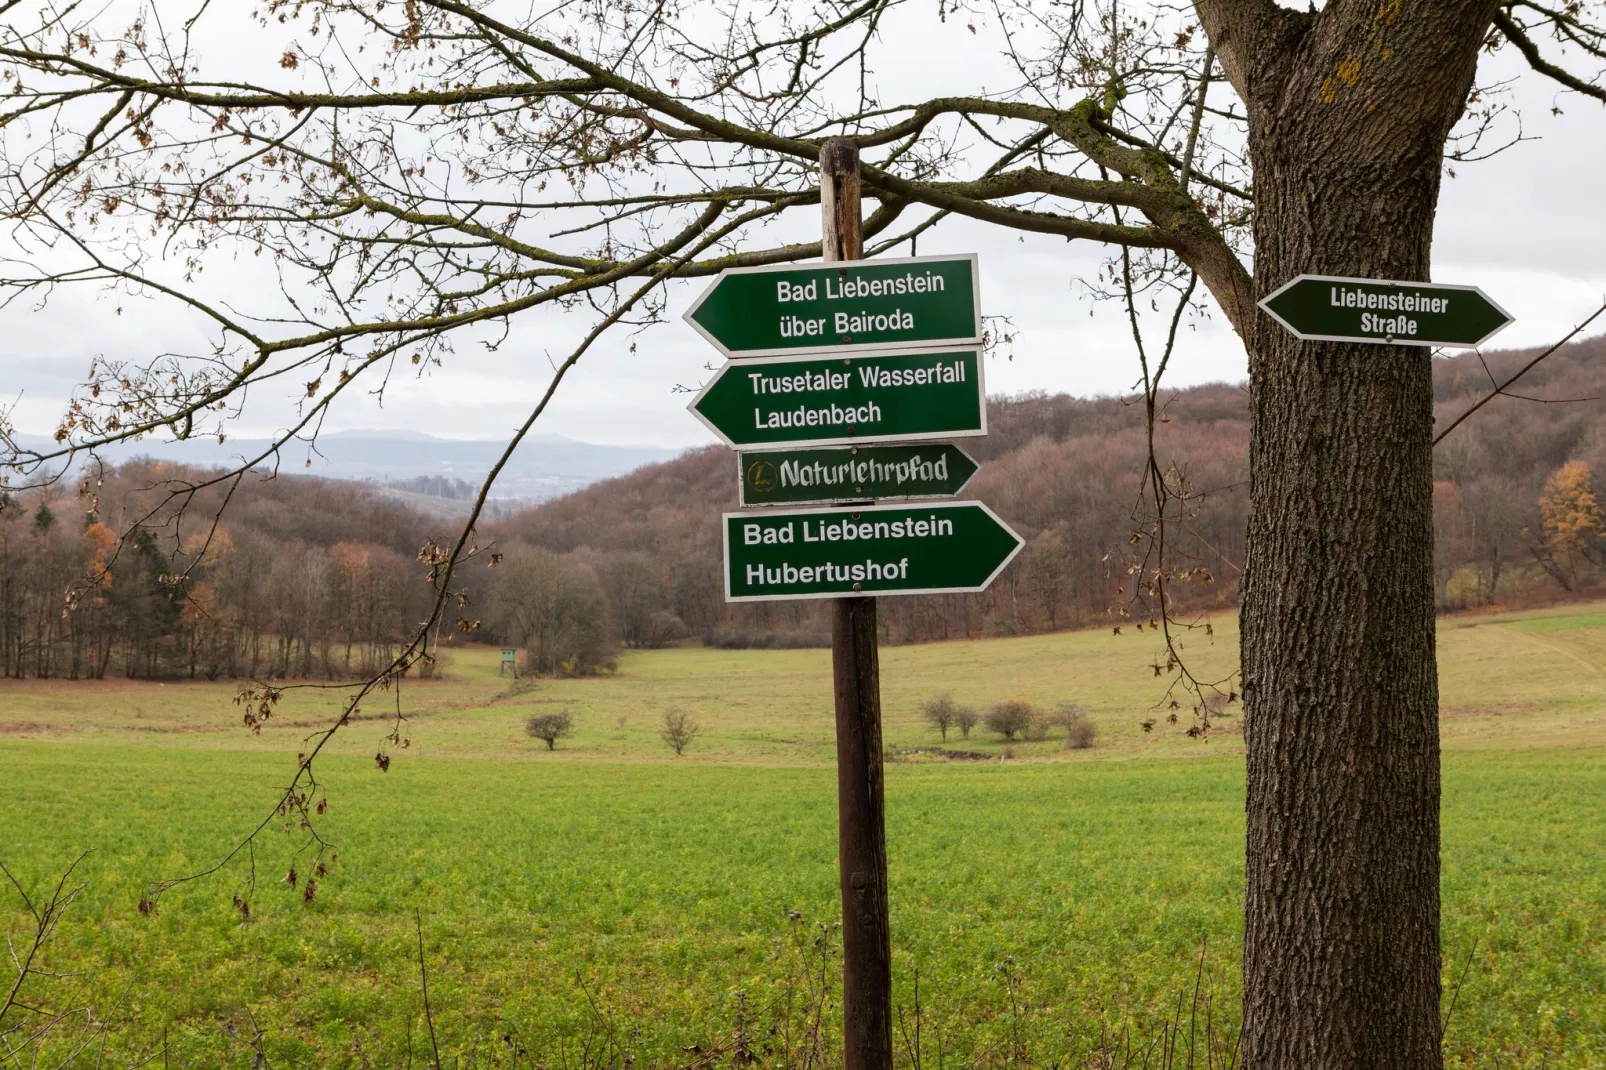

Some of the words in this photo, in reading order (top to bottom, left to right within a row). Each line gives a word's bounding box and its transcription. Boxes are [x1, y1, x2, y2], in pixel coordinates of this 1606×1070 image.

[778, 280, 817, 302] Bad
[825, 271, 945, 299] Liebenstein
[1331, 287, 1448, 313] Liebensteiner
[780, 316, 826, 337] über
[834, 309, 914, 333] Bairoda
[1361, 312, 1418, 335] Straße
[748, 370, 851, 394] Trusetaler
[858, 361, 966, 387] Wasserfall
[755, 401, 881, 429] Laudenbach
[780, 453, 948, 488] Naturlehrpfad
[743, 522, 794, 545] Bad
[803, 515, 953, 542] Liebenstein
[746, 557, 908, 585] Hubertushof
